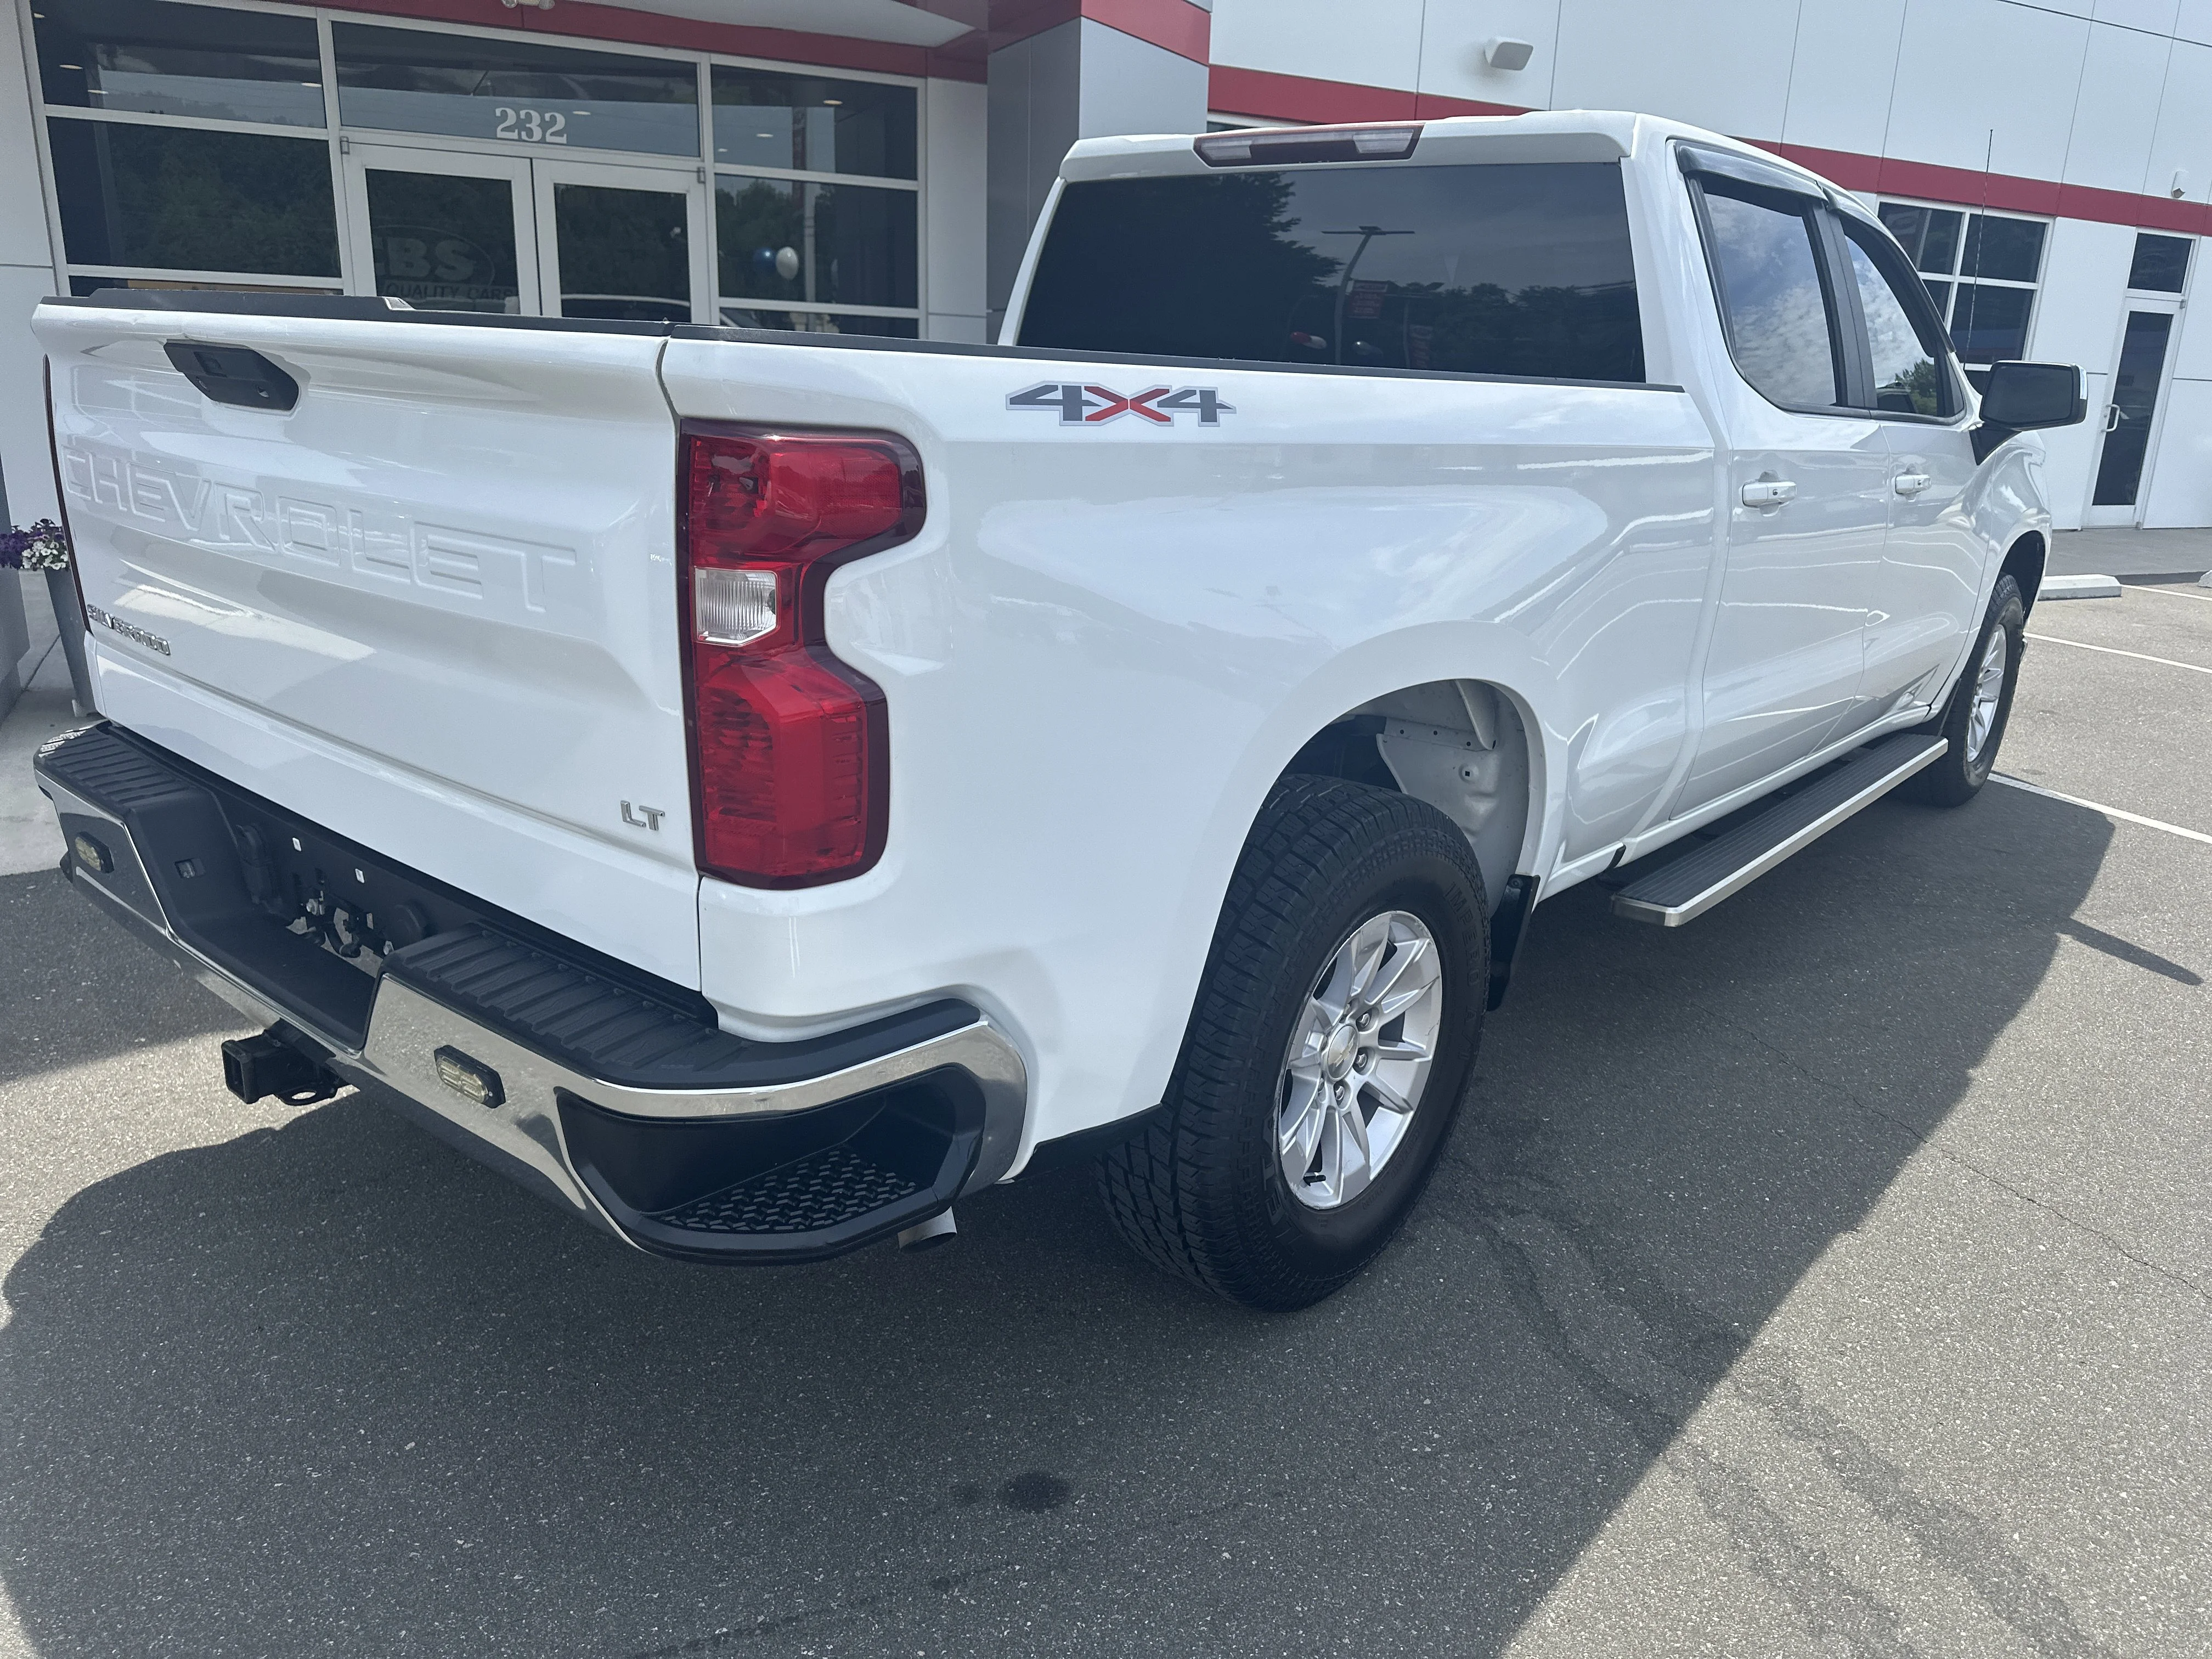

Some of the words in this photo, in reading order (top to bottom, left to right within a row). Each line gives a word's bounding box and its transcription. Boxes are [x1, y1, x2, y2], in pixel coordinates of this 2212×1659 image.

[495, 107, 567, 144] 232
[386, 281, 460, 299] QUALITY
[60, 444, 576, 612] CHEVROLET
[87, 604, 171, 656] SILVERADO
[620, 800, 665, 831] LT
